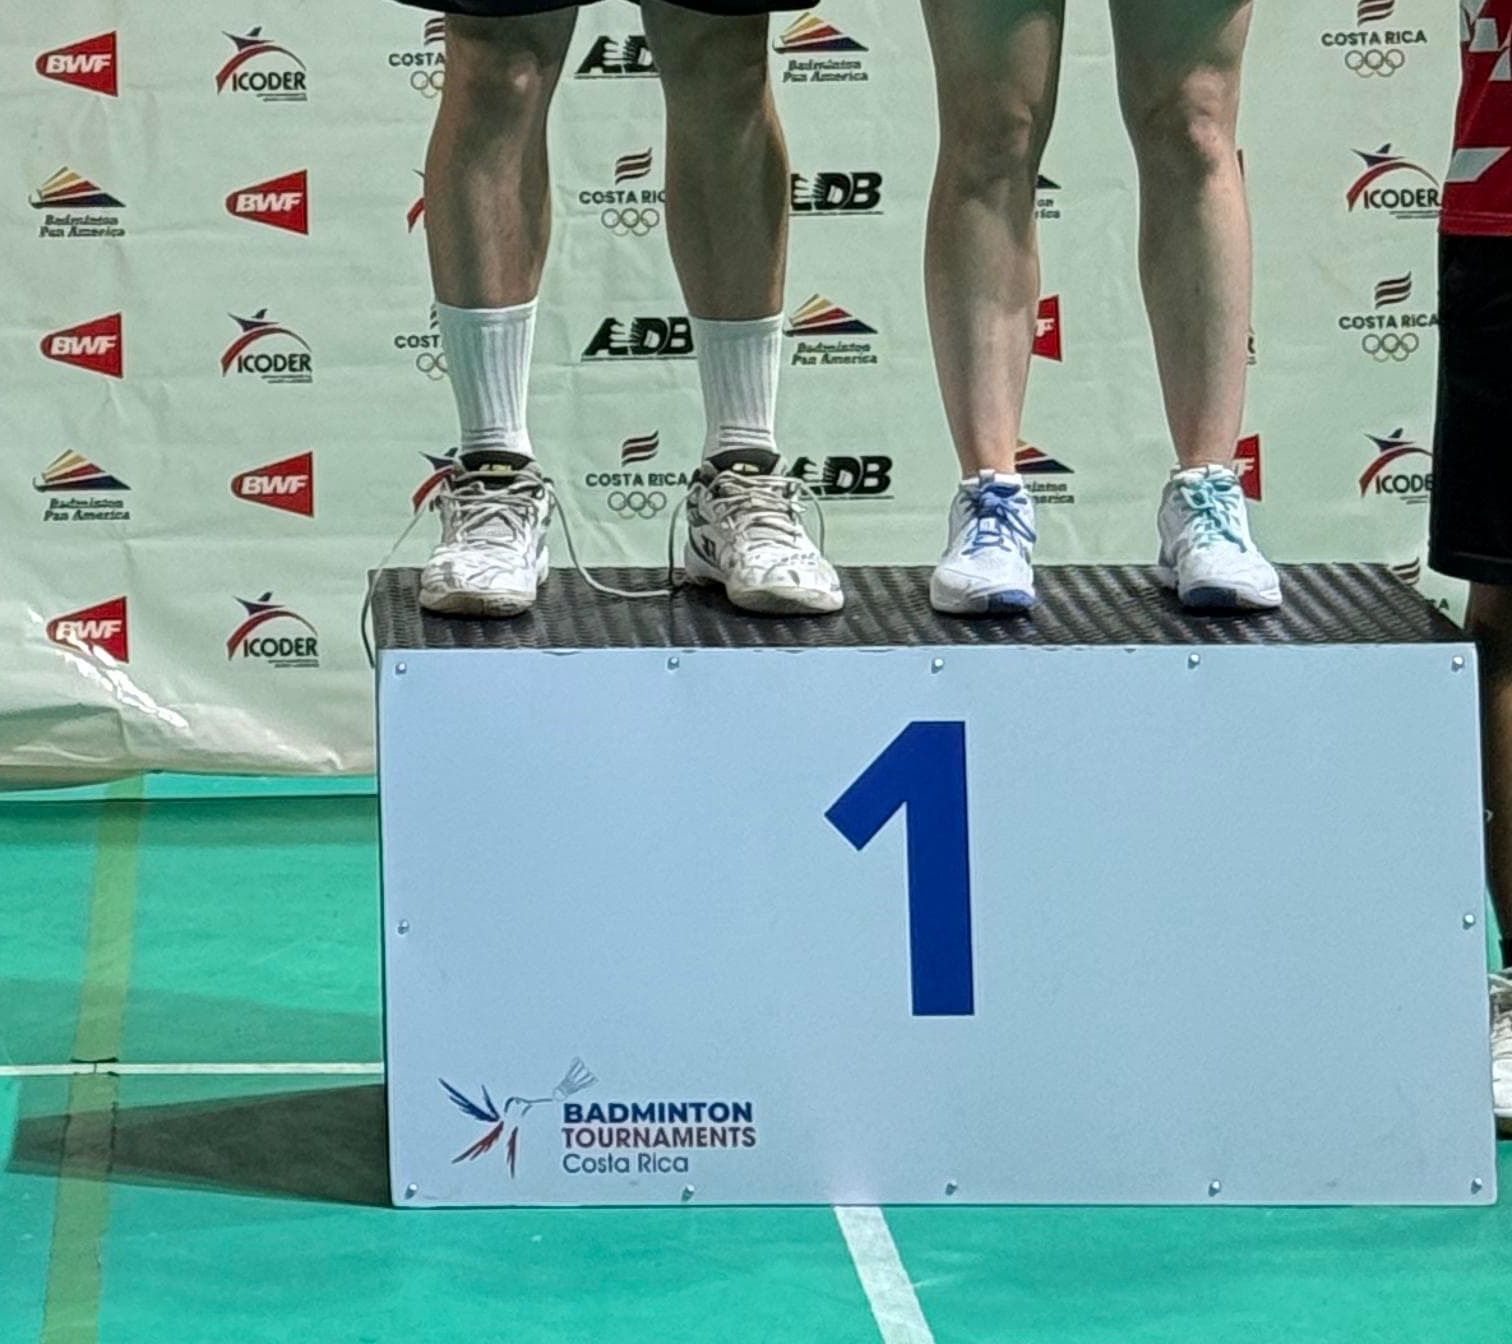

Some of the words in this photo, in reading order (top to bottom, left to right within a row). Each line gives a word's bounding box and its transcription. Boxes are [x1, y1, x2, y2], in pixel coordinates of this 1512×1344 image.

[1321, 31, 1381, 46] COSTA
[1385, 30, 1427, 44] RICA
[45, 53, 112, 73] BWF
[576, 35, 660, 74] AD
[231, 71, 306, 92] ICODER
[236, 192, 303, 212] BWF
[579, 189, 637, 203] COSTA
[641, 189, 666, 203] RIC
[1339, 315, 1398, 330] COSTA
[1401, 313, 1439, 328] RICA
[50, 335, 118, 355] BWF
[394, 334, 441, 348] COST
[237, 353, 313, 373] ICODER
[241, 475, 308, 495] BWF
[585, 472, 644, 487] COSTA
[648, 472, 688, 486] RICA
[1375, 473, 1434, 494] ICODE
[55, 619, 122, 641] BWF
[242, 637, 319, 657] ICODER
[823, 720, 975, 1017] 1
[564, 1101, 753, 1124] BADMINTON
[561, 1126, 757, 1149] TOURNAMENTS
[562, 1153, 630, 1173] Costa
[638, 1152, 689, 1173] Rica
